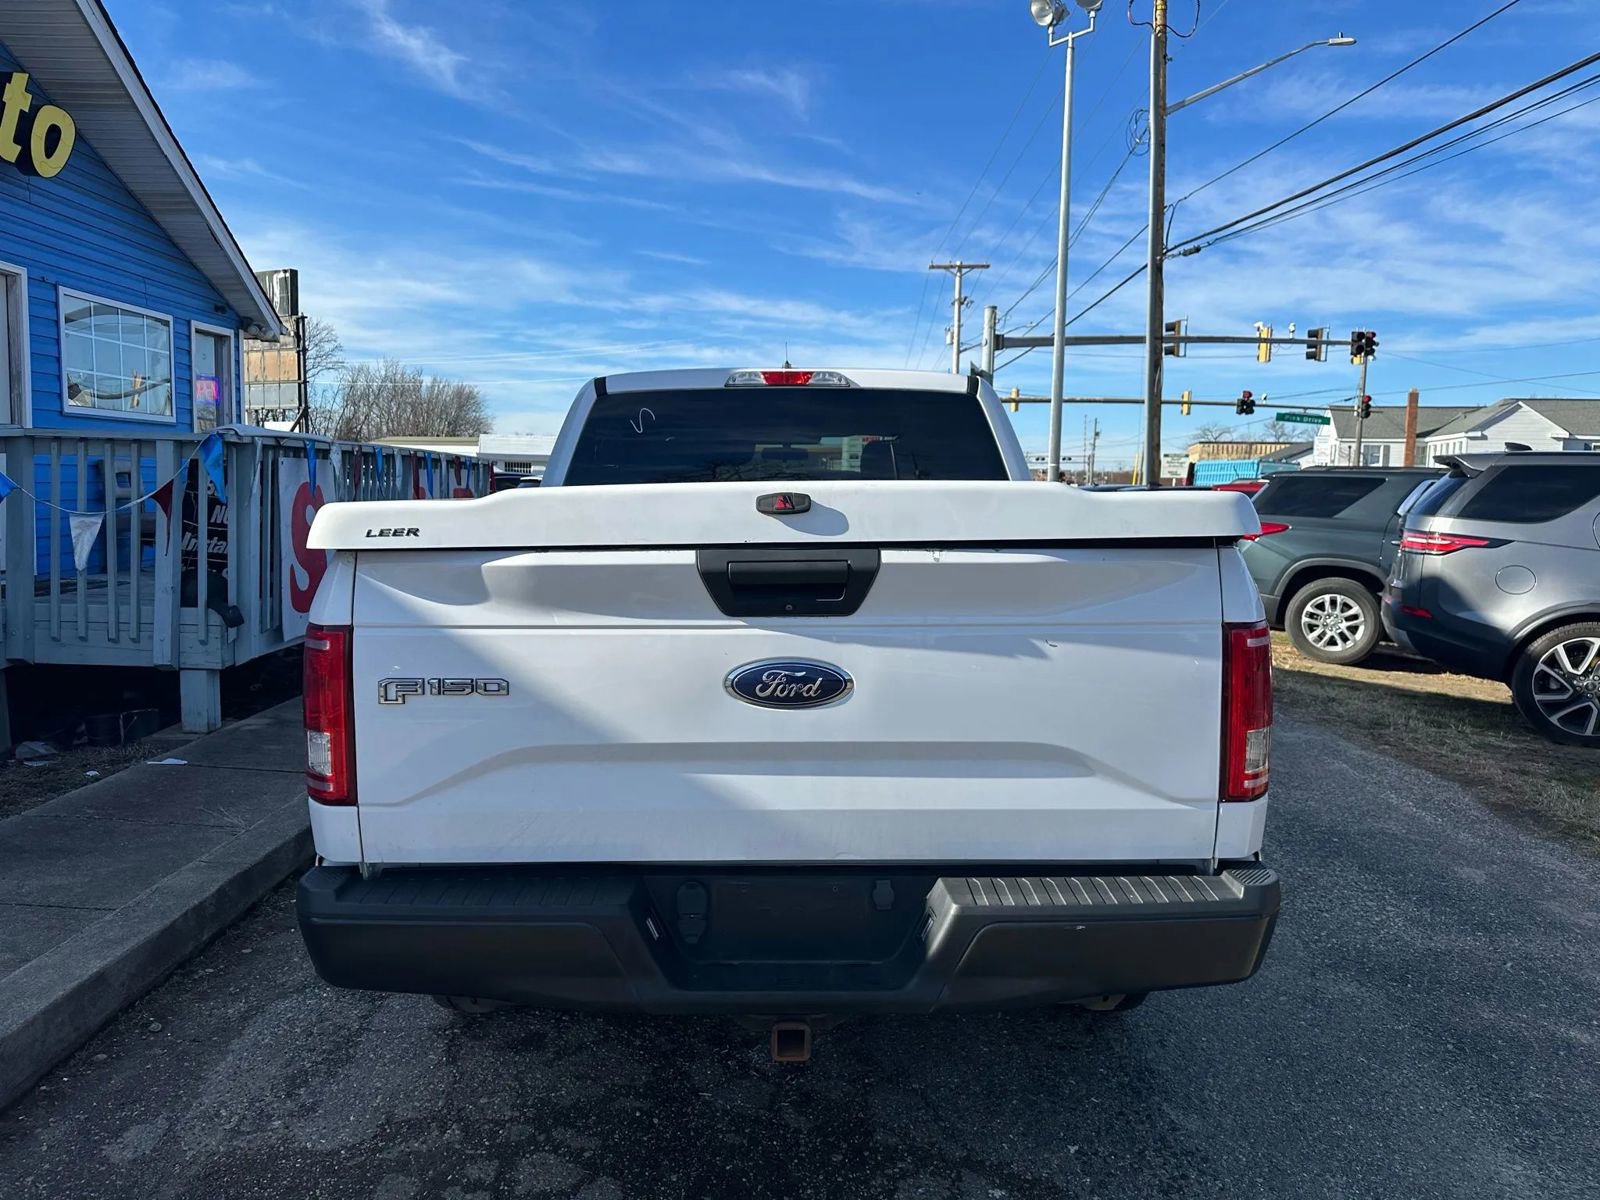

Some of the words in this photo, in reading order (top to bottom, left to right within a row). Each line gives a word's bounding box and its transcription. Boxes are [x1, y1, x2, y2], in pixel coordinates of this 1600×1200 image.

[0, 72, 76, 178] to
[195, 381, 218, 401] PEN
[365, 527, 420, 537] LEER
[755, 669, 823, 697] Ford
